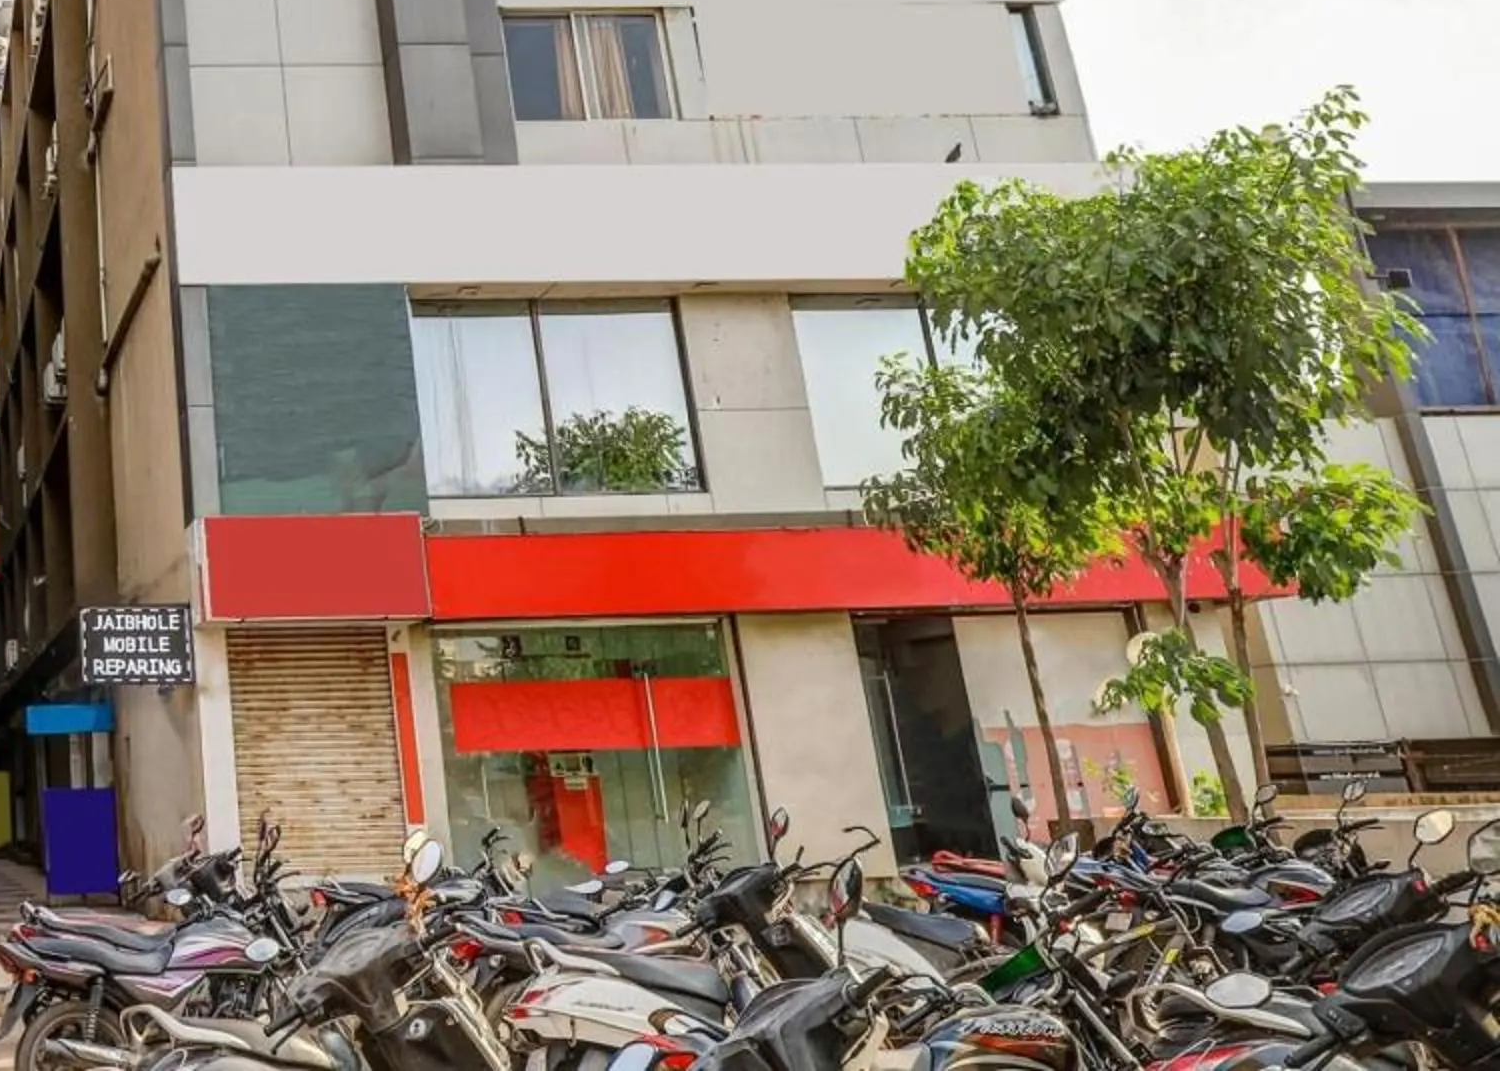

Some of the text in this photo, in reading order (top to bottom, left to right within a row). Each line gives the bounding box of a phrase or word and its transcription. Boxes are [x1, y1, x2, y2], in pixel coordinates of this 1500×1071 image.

[92, 614, 181, 631] JAIBHOLE
[103, 636, 171, 653] MOBILE
[93, 658, 182, 675] REPARING
